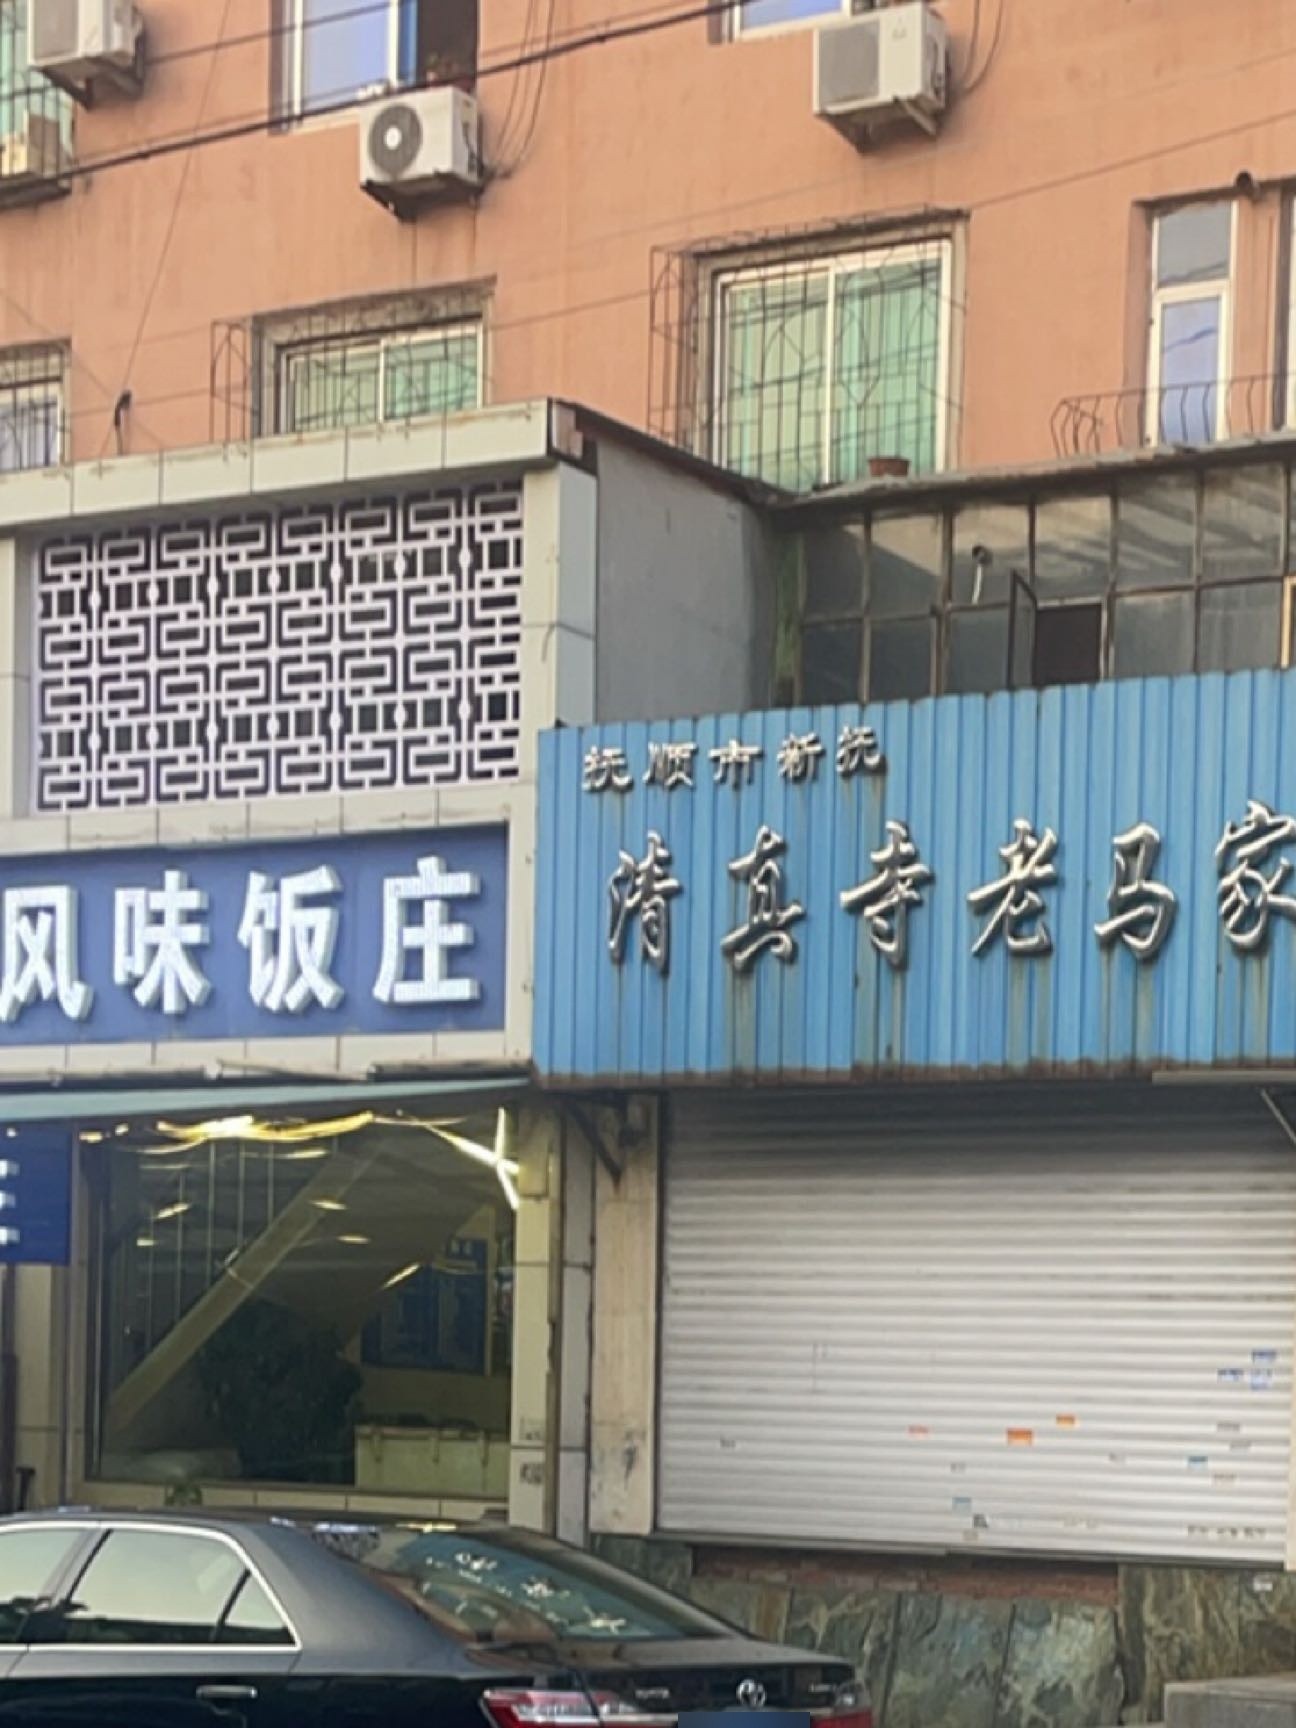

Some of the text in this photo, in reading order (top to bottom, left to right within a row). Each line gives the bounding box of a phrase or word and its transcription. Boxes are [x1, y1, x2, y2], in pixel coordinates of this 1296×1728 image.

[582, 725, 886, 792] 抚顺市新抚
[0, 855, 484, 1022] 风味饭庄
